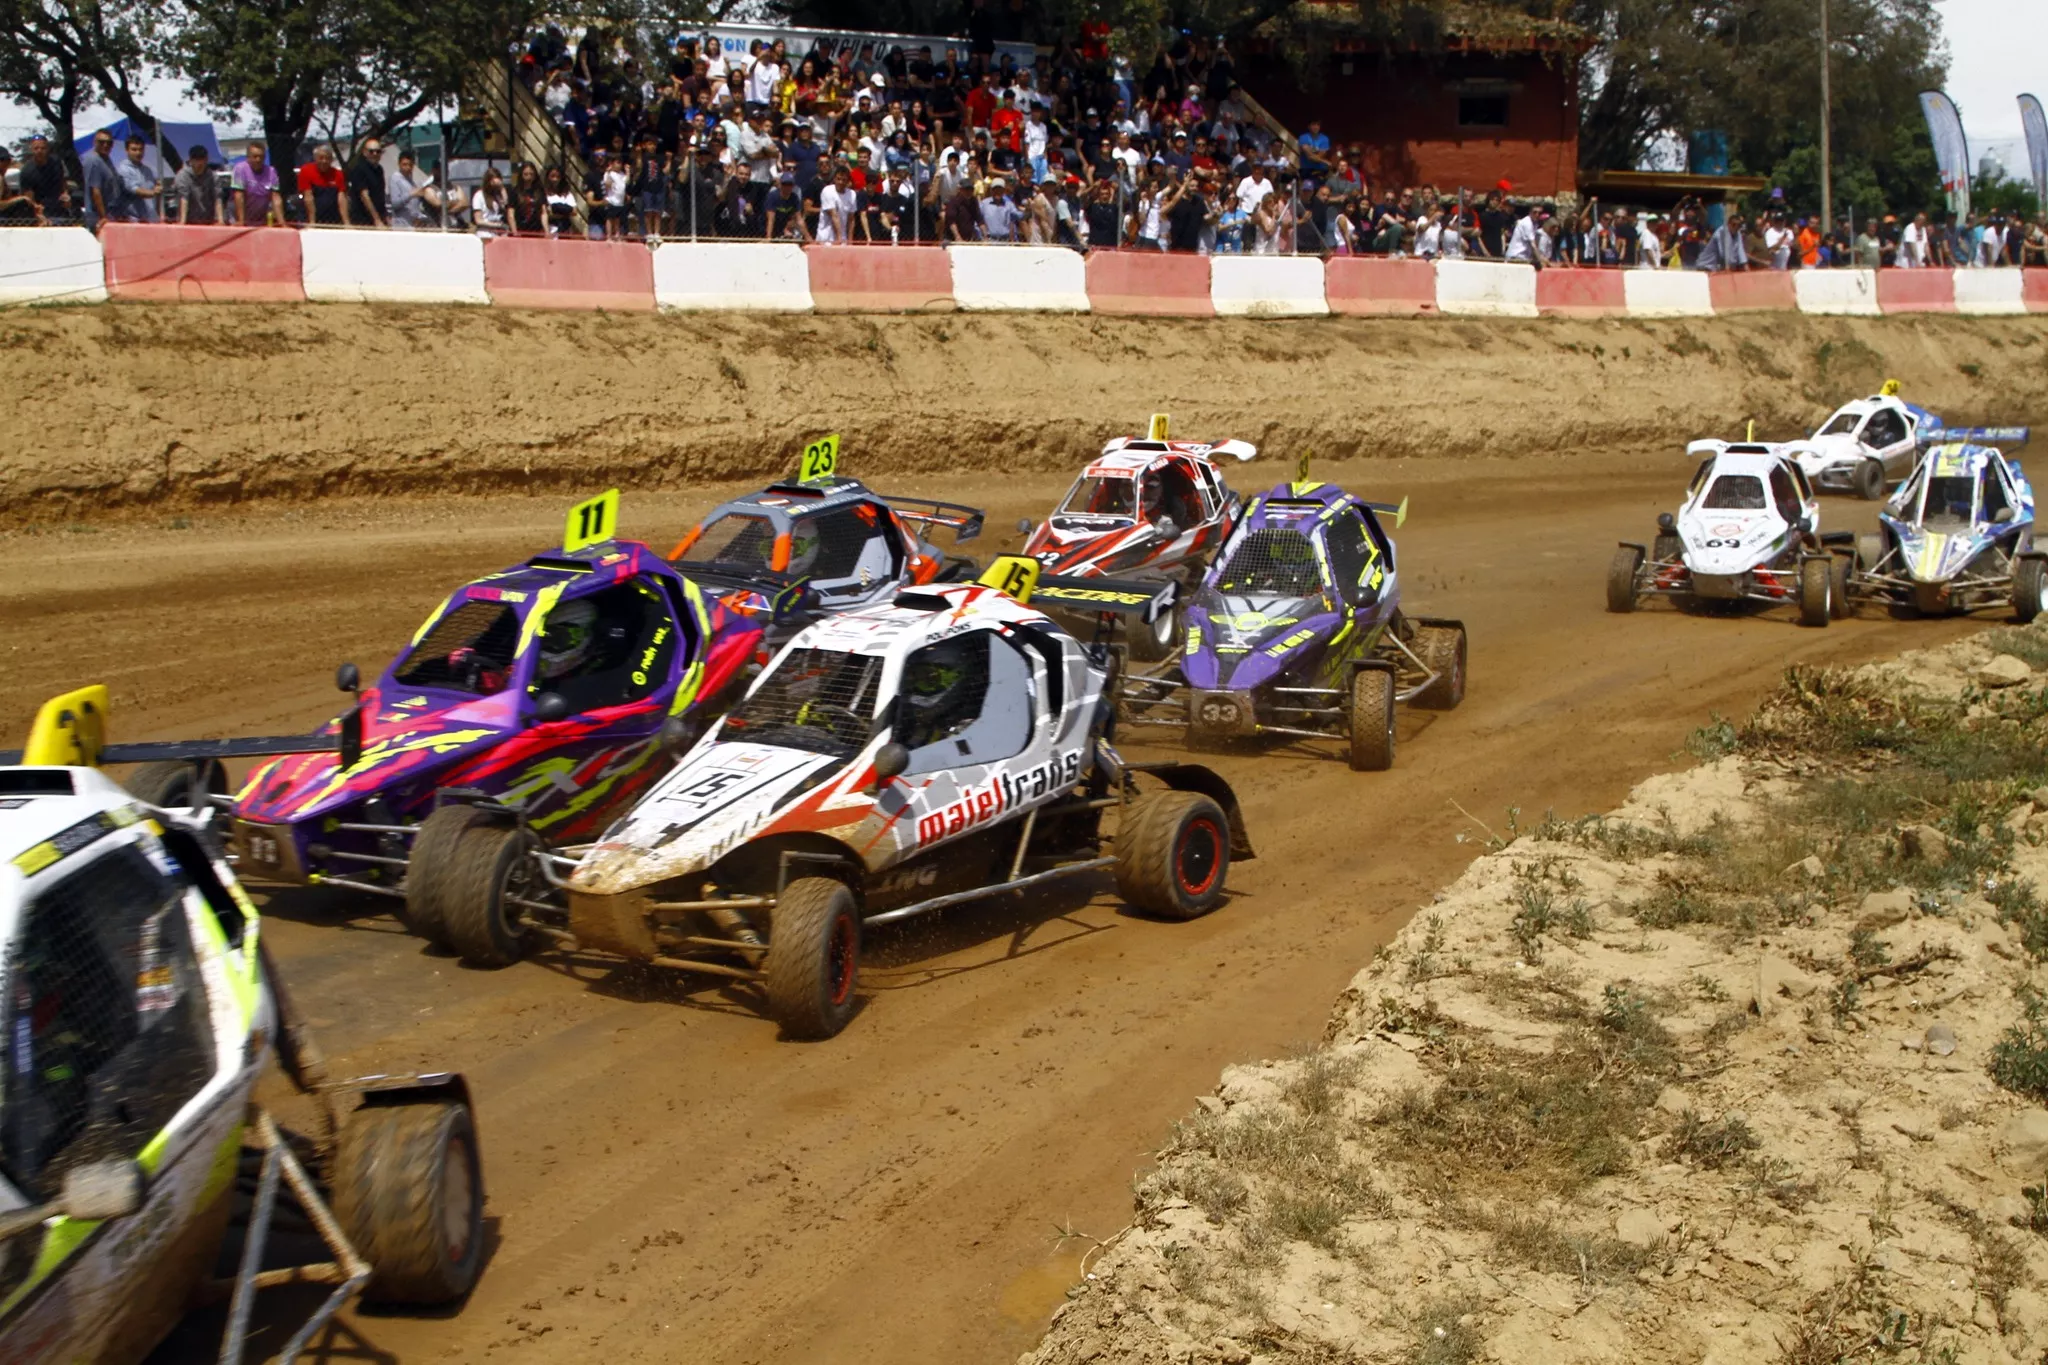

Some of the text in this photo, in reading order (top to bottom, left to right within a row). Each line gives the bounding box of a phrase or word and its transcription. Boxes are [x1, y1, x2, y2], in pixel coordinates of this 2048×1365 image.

[807, 442, 833, 476] 23
[579, 499, 606, 540] 11
[1001, 561, 1031, 597] 15
[1202, 703, 1238, 722] 33
[677, 772, 746, 798] 15
